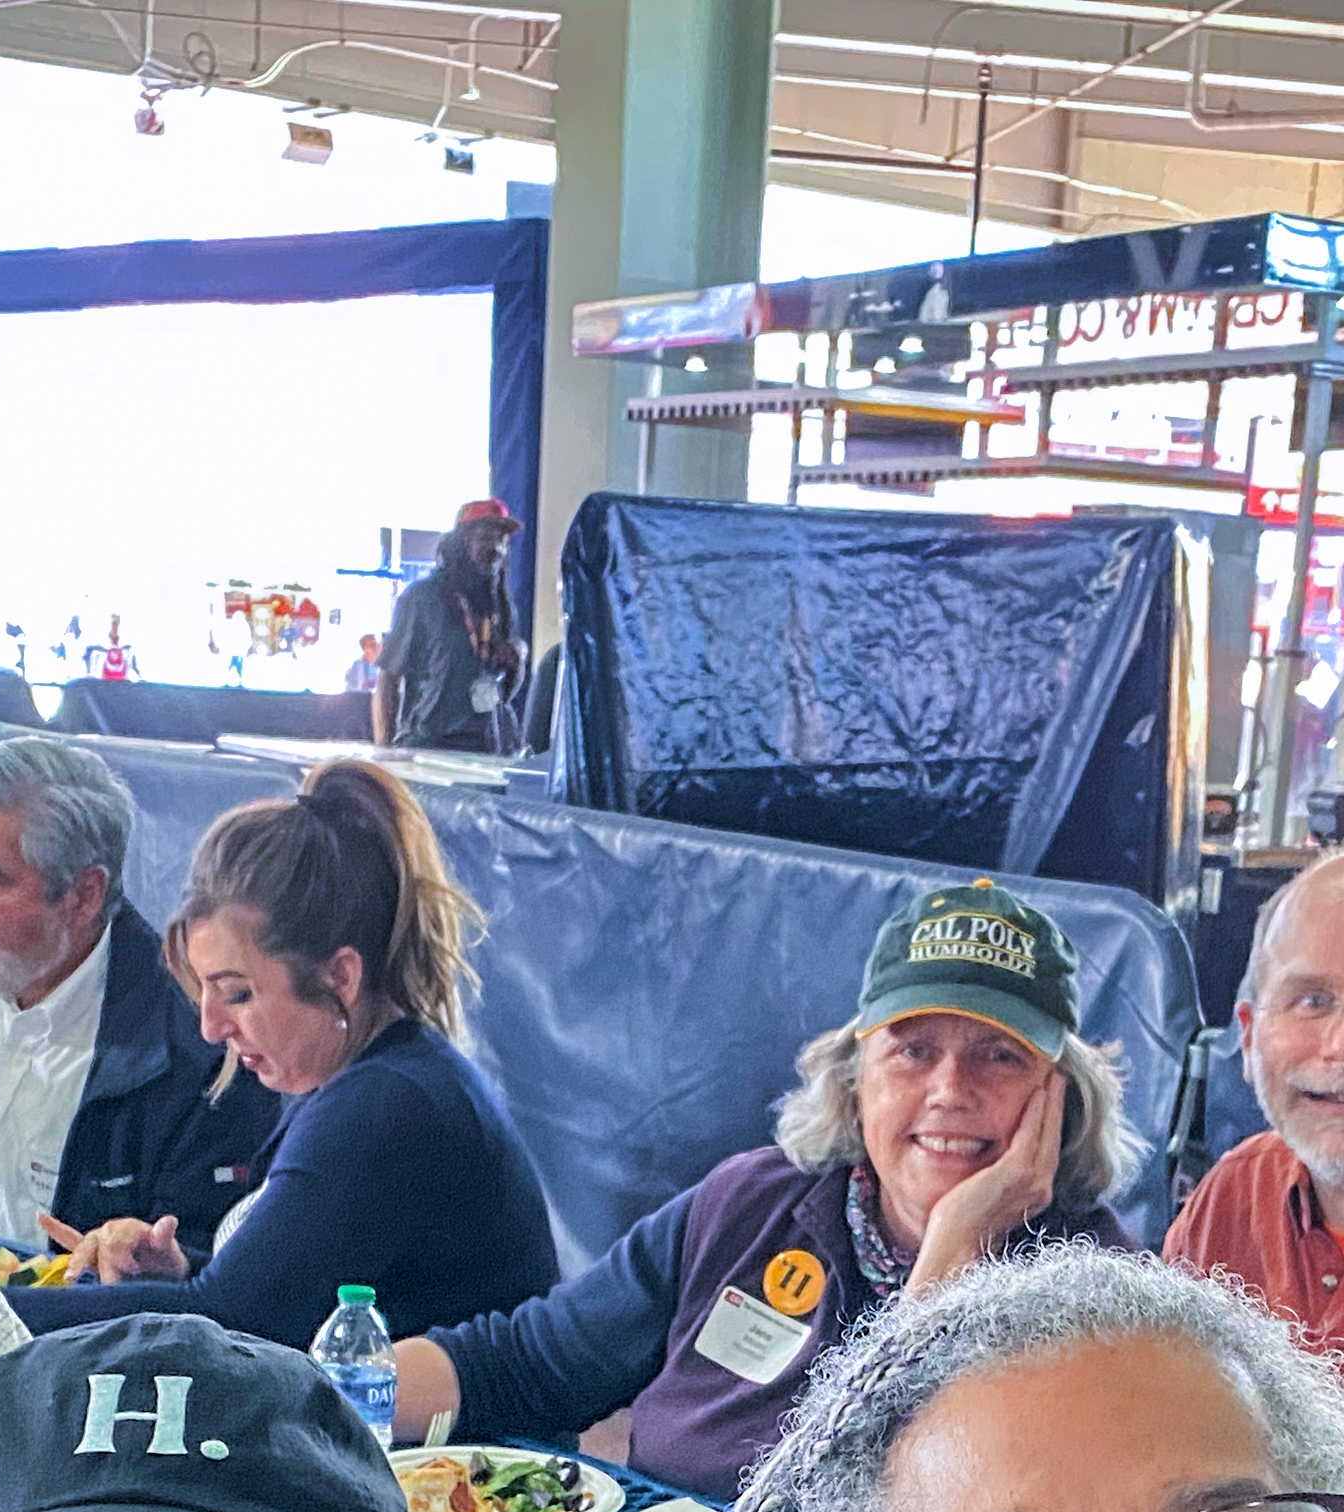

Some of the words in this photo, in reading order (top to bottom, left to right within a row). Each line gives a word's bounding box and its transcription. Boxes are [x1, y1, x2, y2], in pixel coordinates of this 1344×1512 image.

[911, 917, 962, 945] CAL
[968, 917, 1037, 958] POLY
[909, 943, 1037, 977] HUMBOLDT
[73, 1373, 230, 1460] H.
